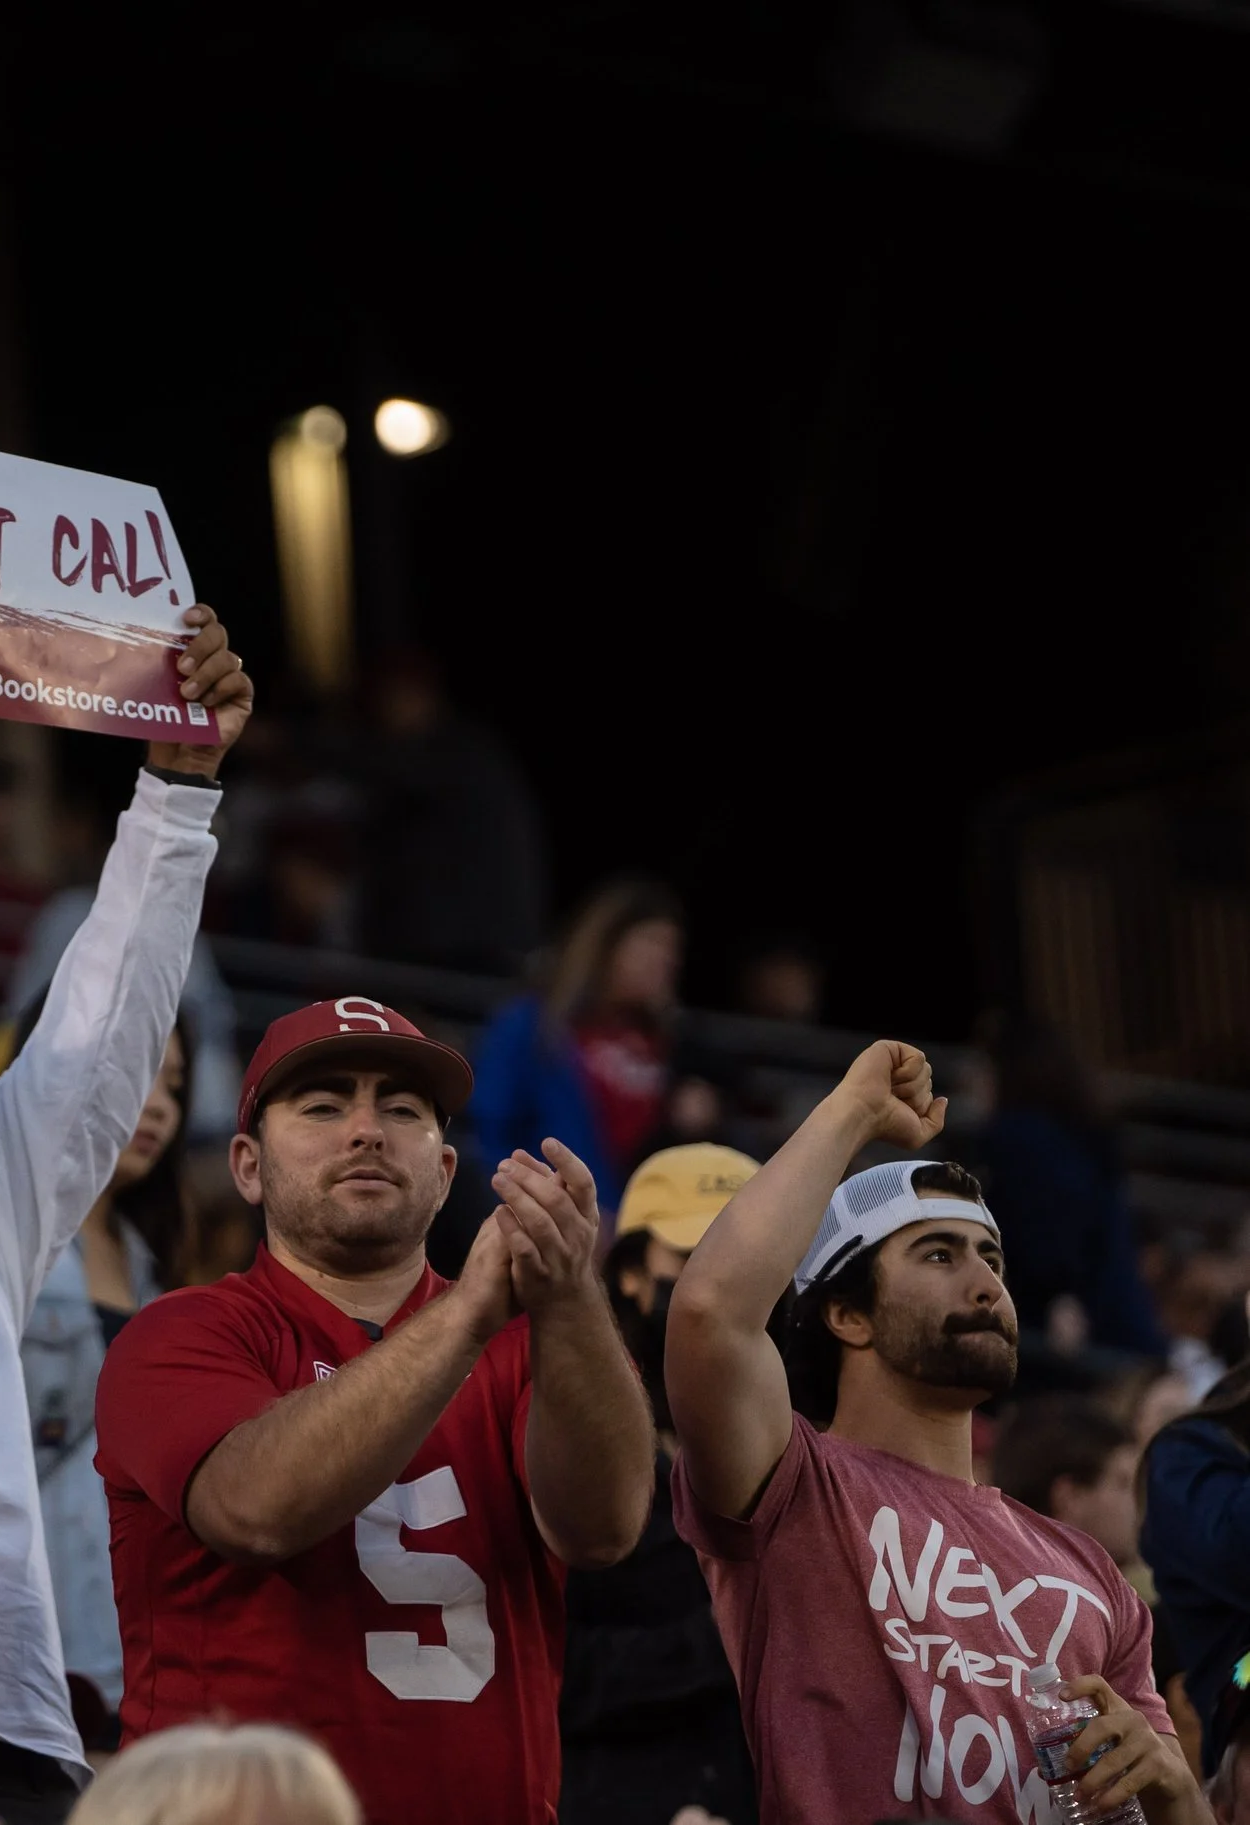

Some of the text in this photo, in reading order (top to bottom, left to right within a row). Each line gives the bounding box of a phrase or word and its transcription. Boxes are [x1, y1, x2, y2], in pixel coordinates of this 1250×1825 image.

[52, 509, 180, 606] CAL!
[354, 1465, 496, 1703] 5
[868, 1505, 1111, 1664] NEXT
